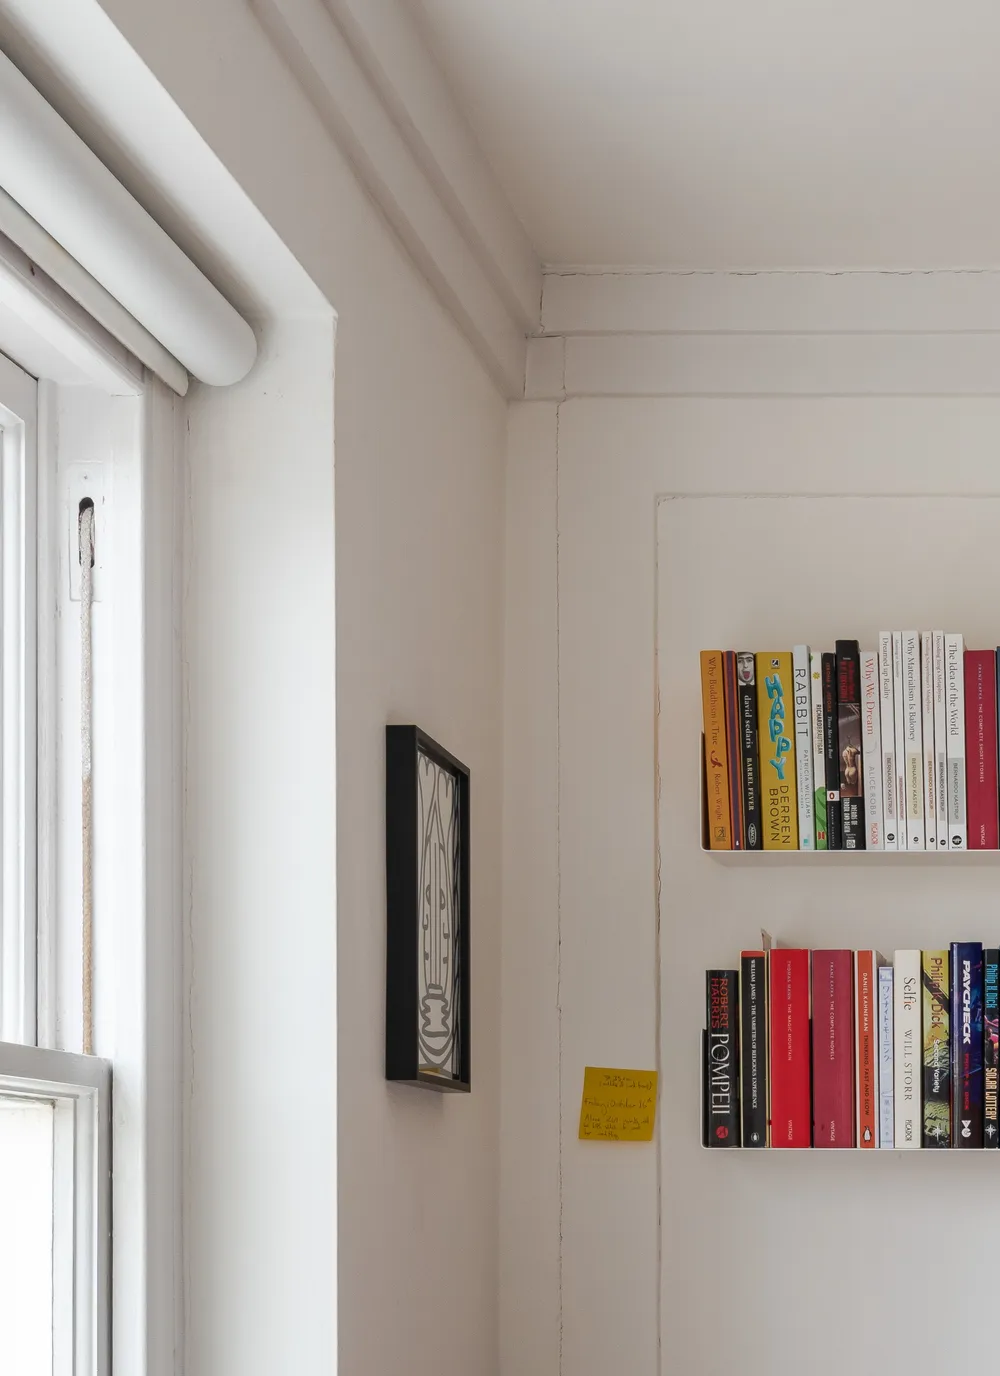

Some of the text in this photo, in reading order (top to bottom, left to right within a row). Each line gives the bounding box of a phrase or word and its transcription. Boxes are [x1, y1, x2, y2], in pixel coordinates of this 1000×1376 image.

[906, 638, 914, 655] Why
[795, 669, 808, 737] RABBIT
[862, 658, 875, 735] Why We Dream
[907, 658, 915, 701] Materialism
[949, 643, 959, 735] The Idea of the World
[744, 695, 752, 717] david
[764, 674, 792, 779] HAPPY
[908, 712, 916, 741] Baloney
[715, 798, 723, 820] Wright
[769, 788, 779, 841] BROWN
[780, 785, 790, 843] DERREN
[711, 978, 720, 1029] HARRIS
[720, 978, 728, 1029] ROBERT
[903, 977, 916, 1011] Selfie
[963, 960, 971, 1044] PAYCHECK
[711, 1033, 730, 1114] POMPEII
[904, 1029, 912, 1101] WILL STORR
[986, 1068, 997, 1120] SOLAR LOTTERY
